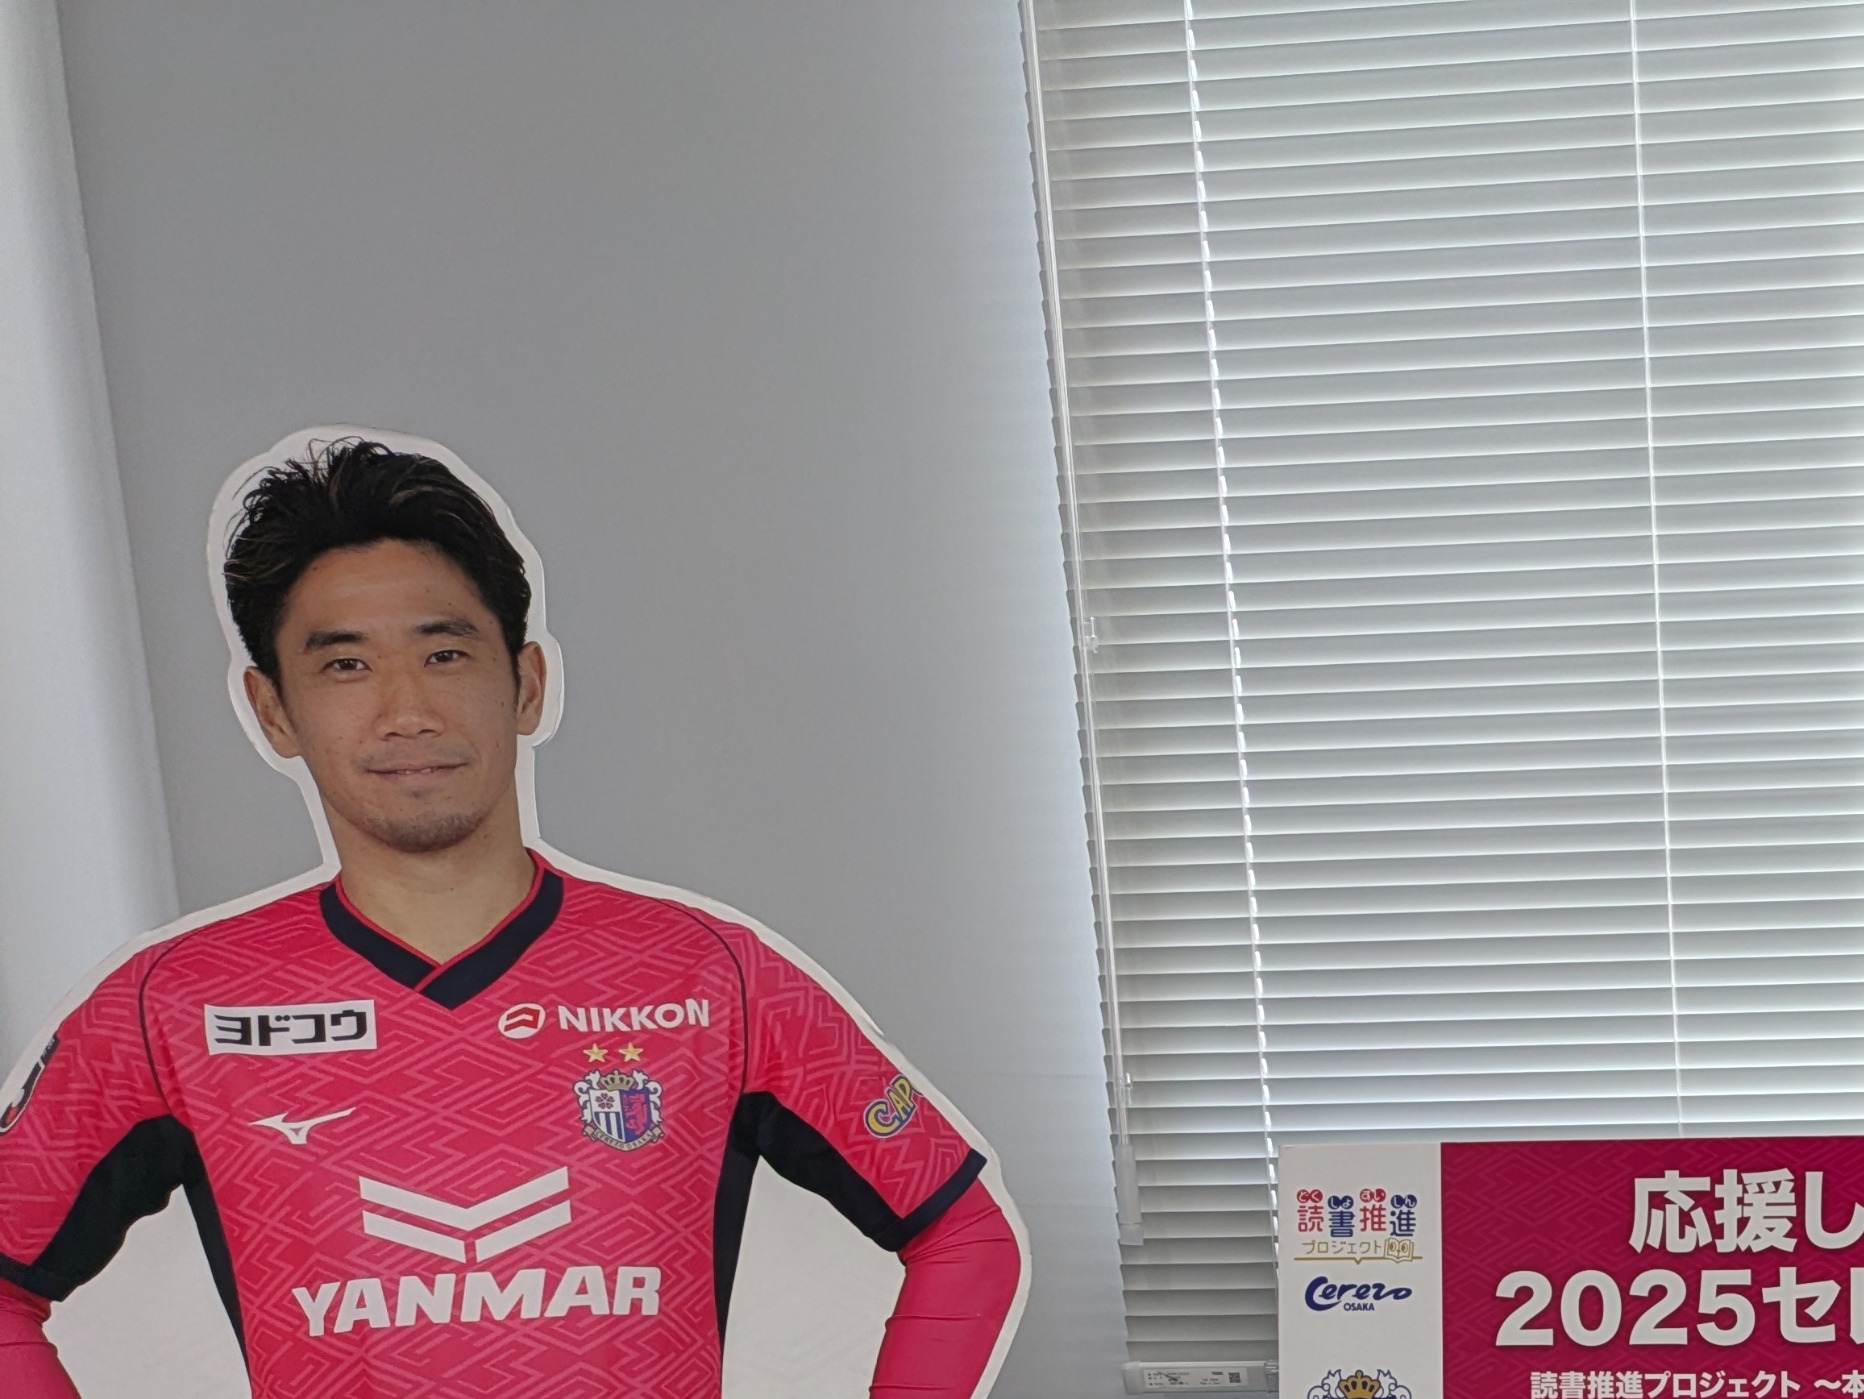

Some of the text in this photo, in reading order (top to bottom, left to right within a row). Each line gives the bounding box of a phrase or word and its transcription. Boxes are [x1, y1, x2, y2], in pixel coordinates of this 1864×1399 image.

[213, 1009, 368, 1046] ヨドコウ
[558, 997, 710, 1033] NIKKON
[863, 1074, 924, 1139] CAP
[1296, 1204, 1417, 1238] 読書推進
[1302, 1239, 1382, 1255] プロジェクト
[292, 1265, 662, 1337] YANMAR
[1304, 1276, 1413, 1312] Cerezo
[1343, 1302, 1376, 1312] OSAKA
[1530, 1371, 1800, 1399] 読書推進プロジェクト
